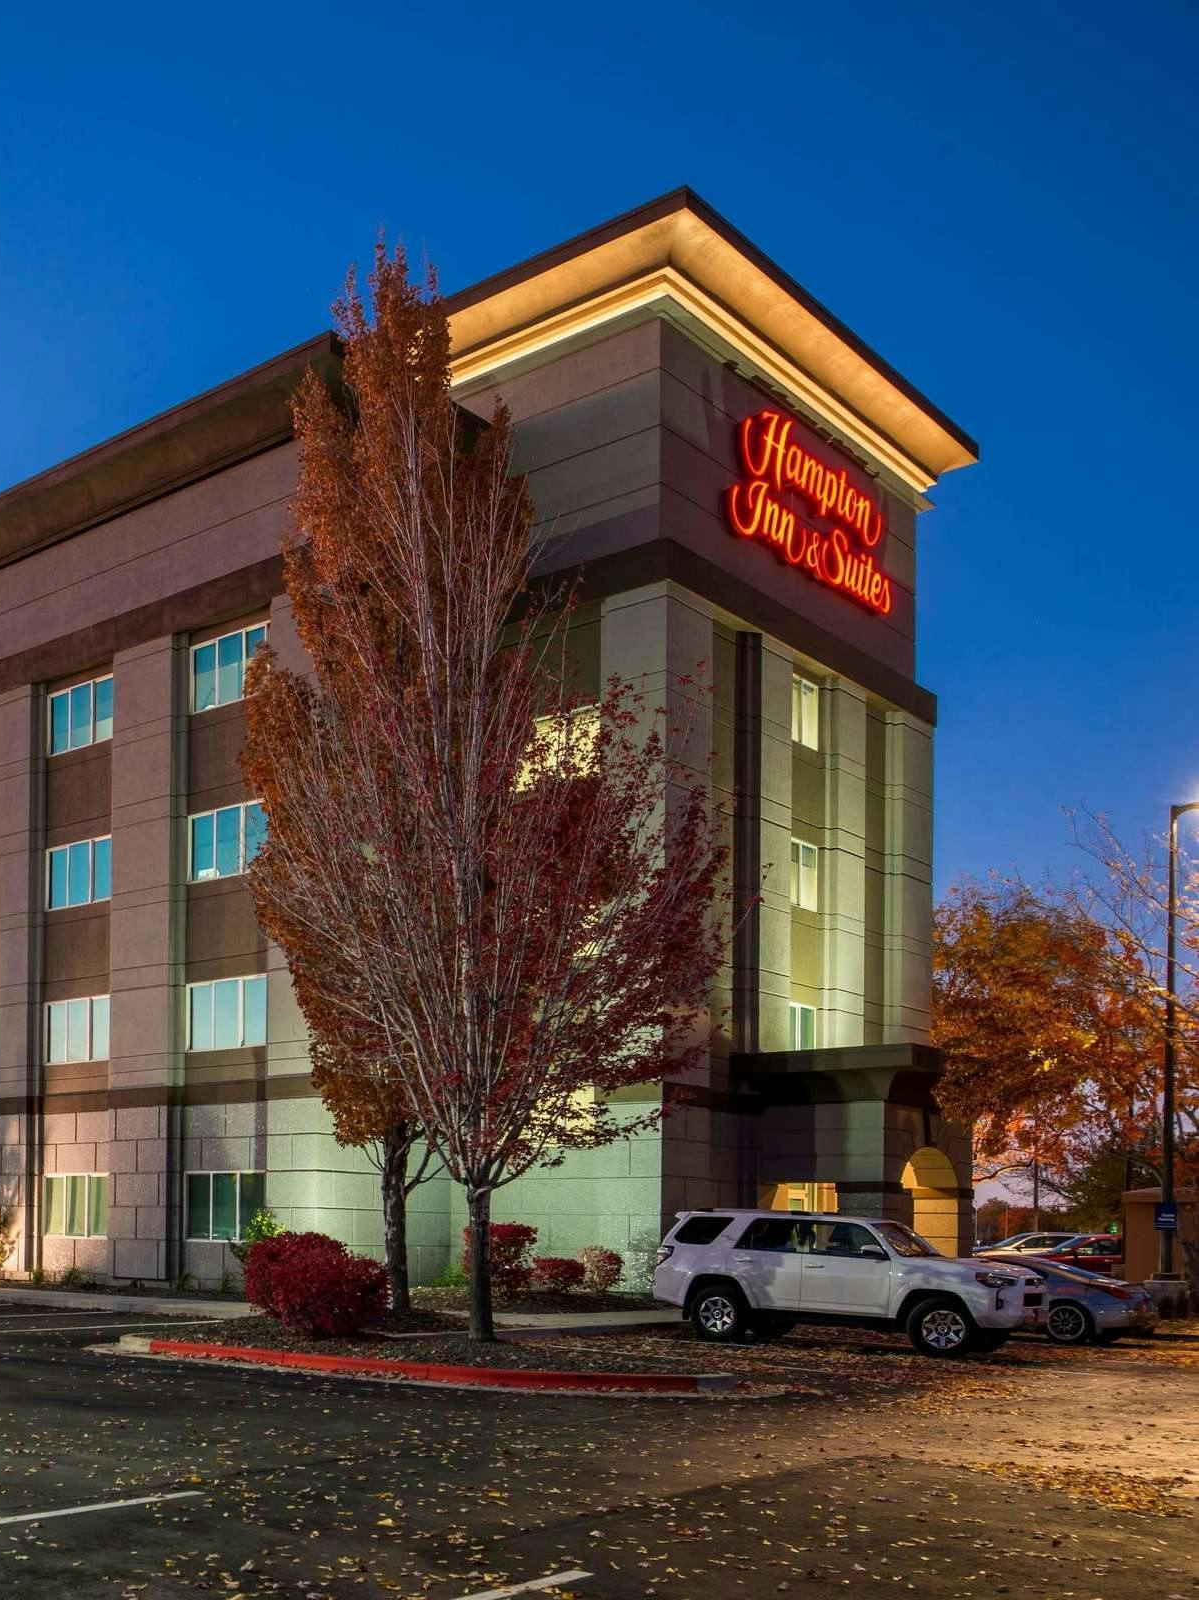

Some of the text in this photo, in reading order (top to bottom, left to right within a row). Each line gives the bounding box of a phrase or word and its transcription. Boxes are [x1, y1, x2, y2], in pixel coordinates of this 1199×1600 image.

[743, 411, 882, 547] Hampton
[731, 481, 891, 614] Inn & Suites
